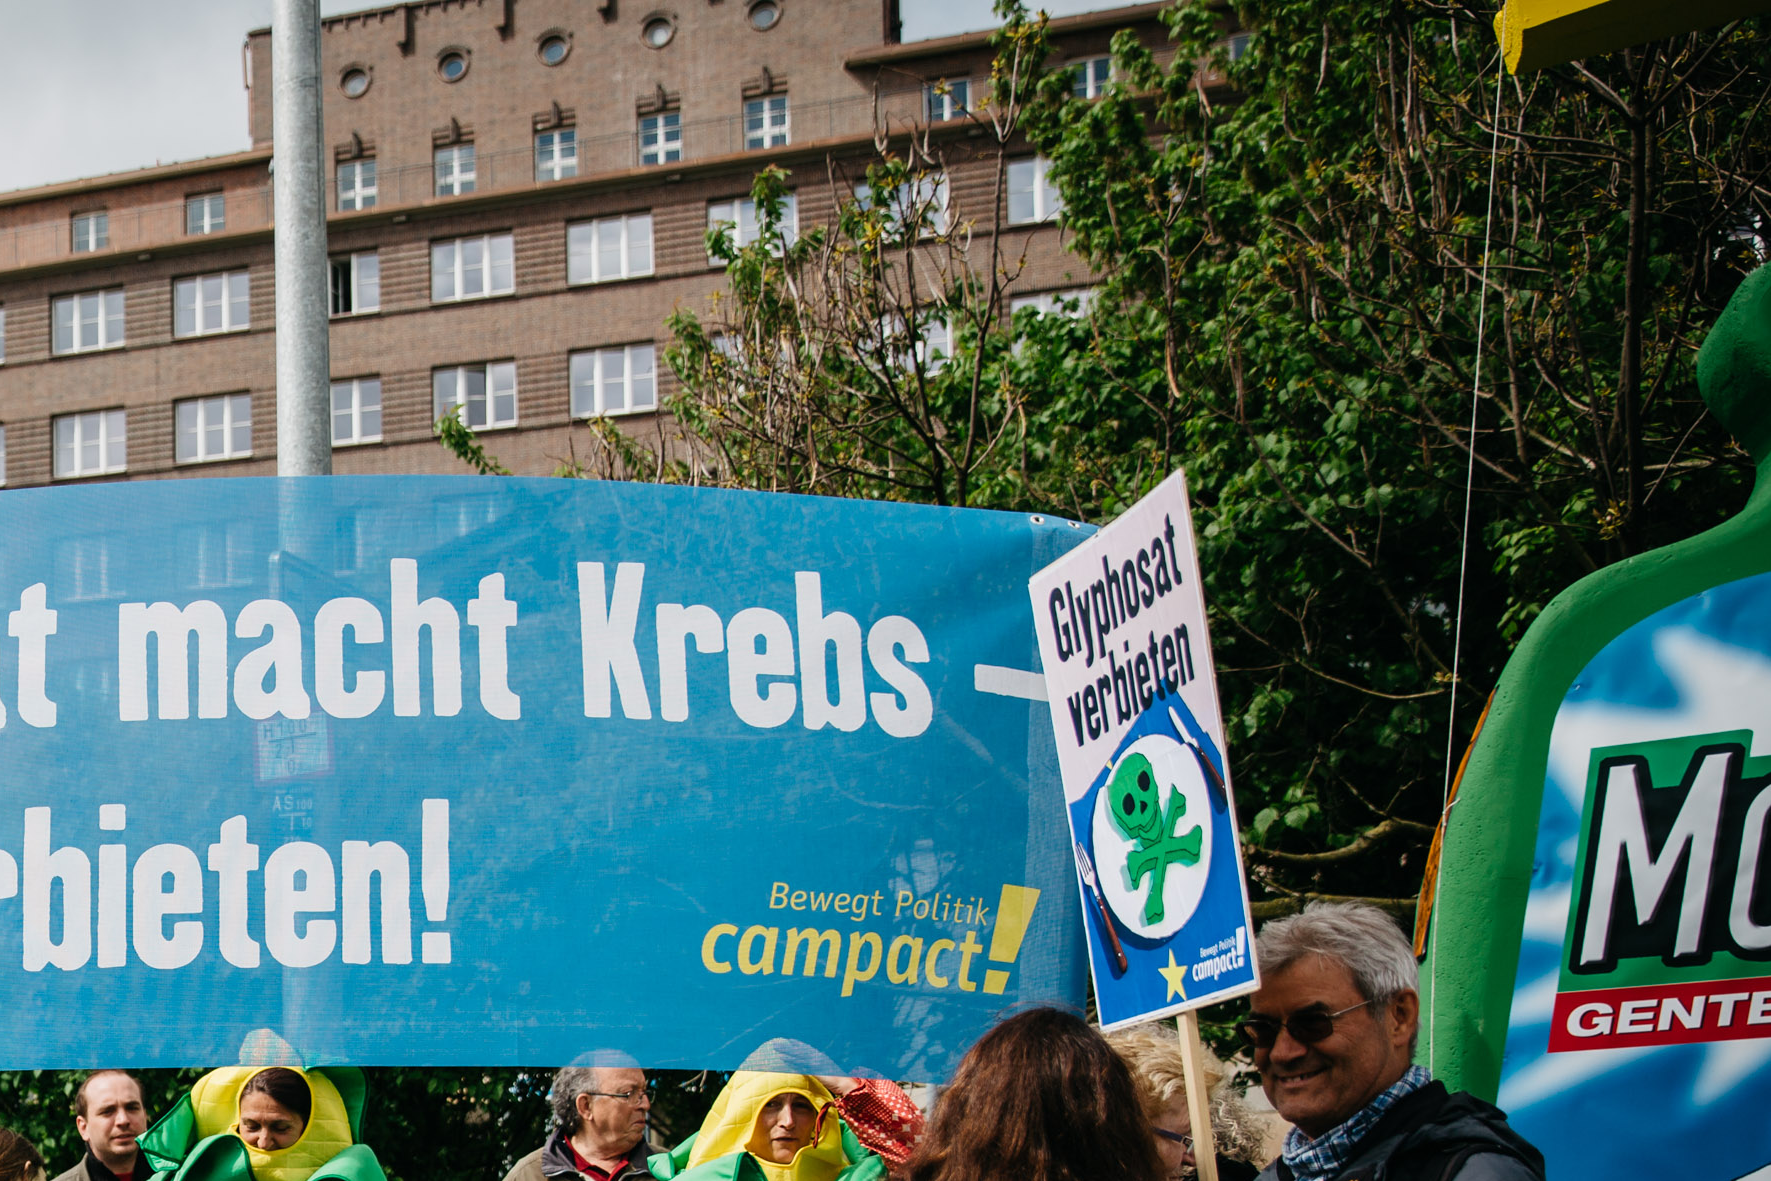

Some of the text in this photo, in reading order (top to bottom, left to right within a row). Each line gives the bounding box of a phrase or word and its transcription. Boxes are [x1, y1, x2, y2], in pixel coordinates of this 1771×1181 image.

[118, 557, 521, 722] macht
[577, 561, 933, 738] Krebs
[1049, 512, 1183, 668] Glyphosat
[1065, 621, 1195, 748] verbieten
[701, 883, 1041, 997] campact!
[769, 881, 990, 926] Bewegt Politik
[1192, 925, 1246, 982] campact!
